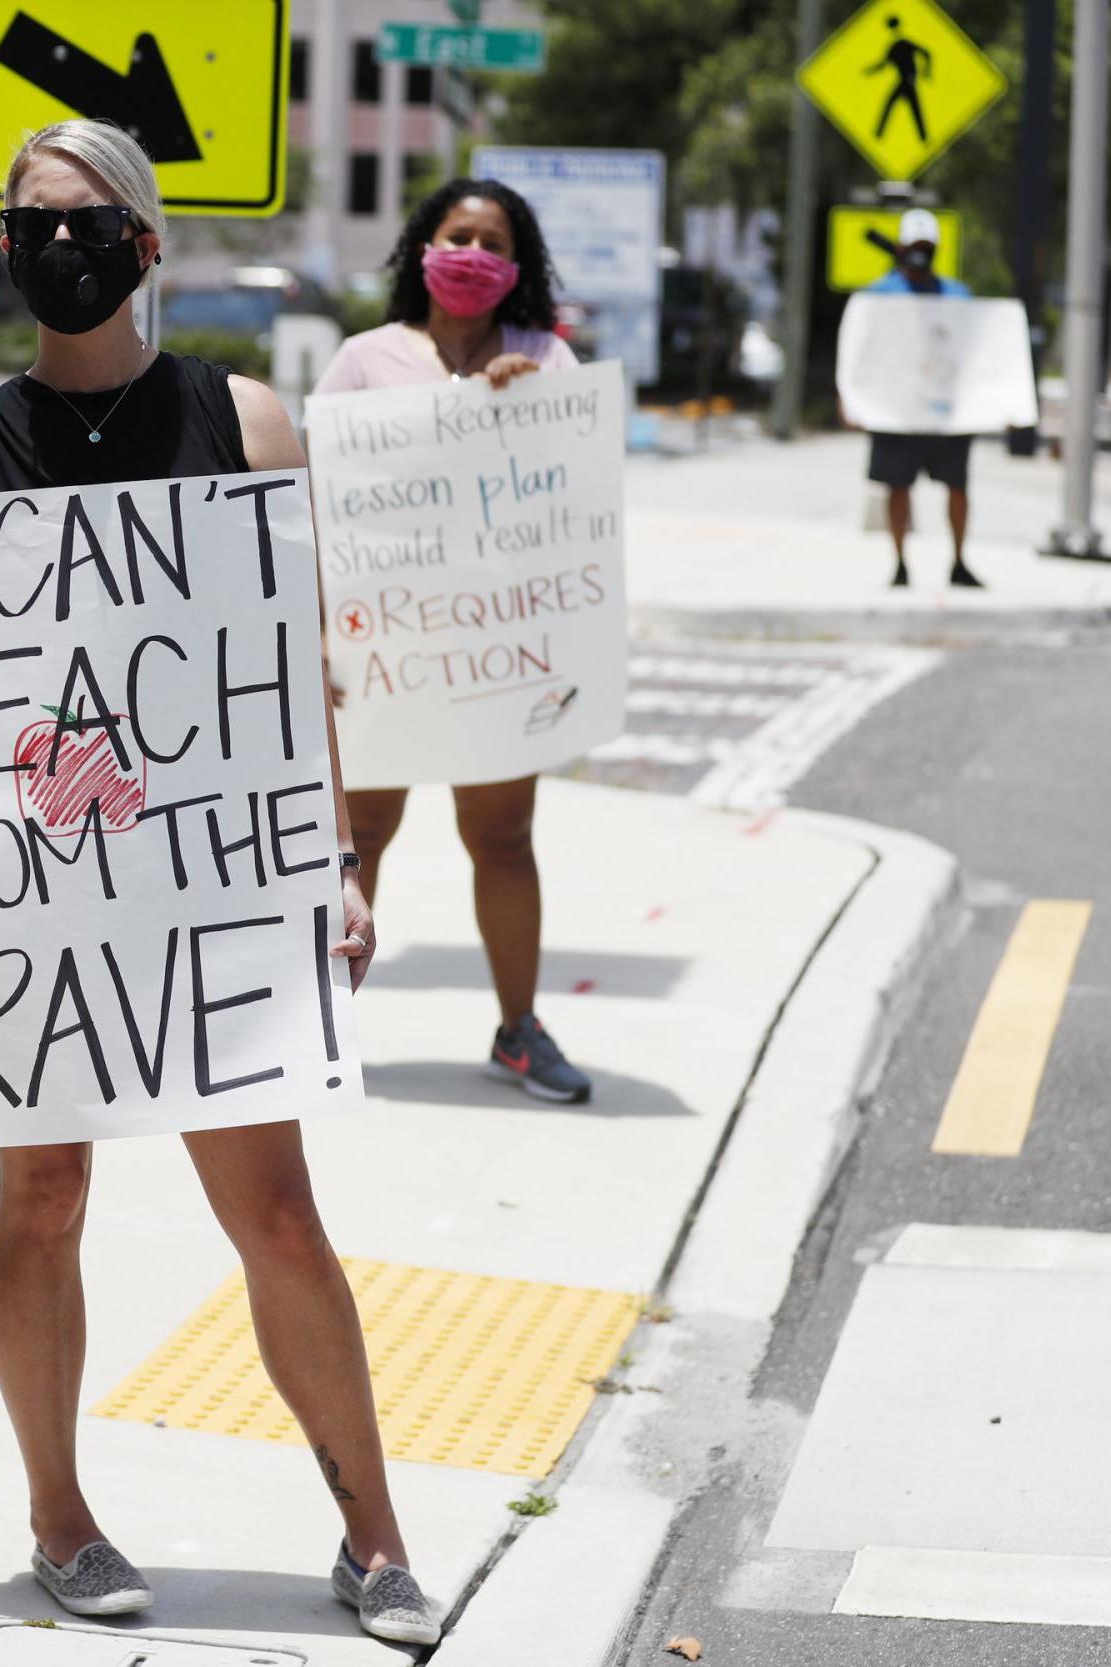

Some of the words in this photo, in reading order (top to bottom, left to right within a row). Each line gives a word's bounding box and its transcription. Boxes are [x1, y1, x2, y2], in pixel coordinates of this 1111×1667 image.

[331, 407, 413, 457] This
[432, 389, 600, 448] Reopening
[327, 474, 454, 524] lesson
[479, 455, 567, 530] plan
[330, 527, 446, 576] should
[476, 505, 577, 558] result
[588, 508, 618, 541] in
[379, 564, 606, 635] REQUIRES
[362, 632, 553, 698] ACTION
[135, 781, 331, 891] THE
